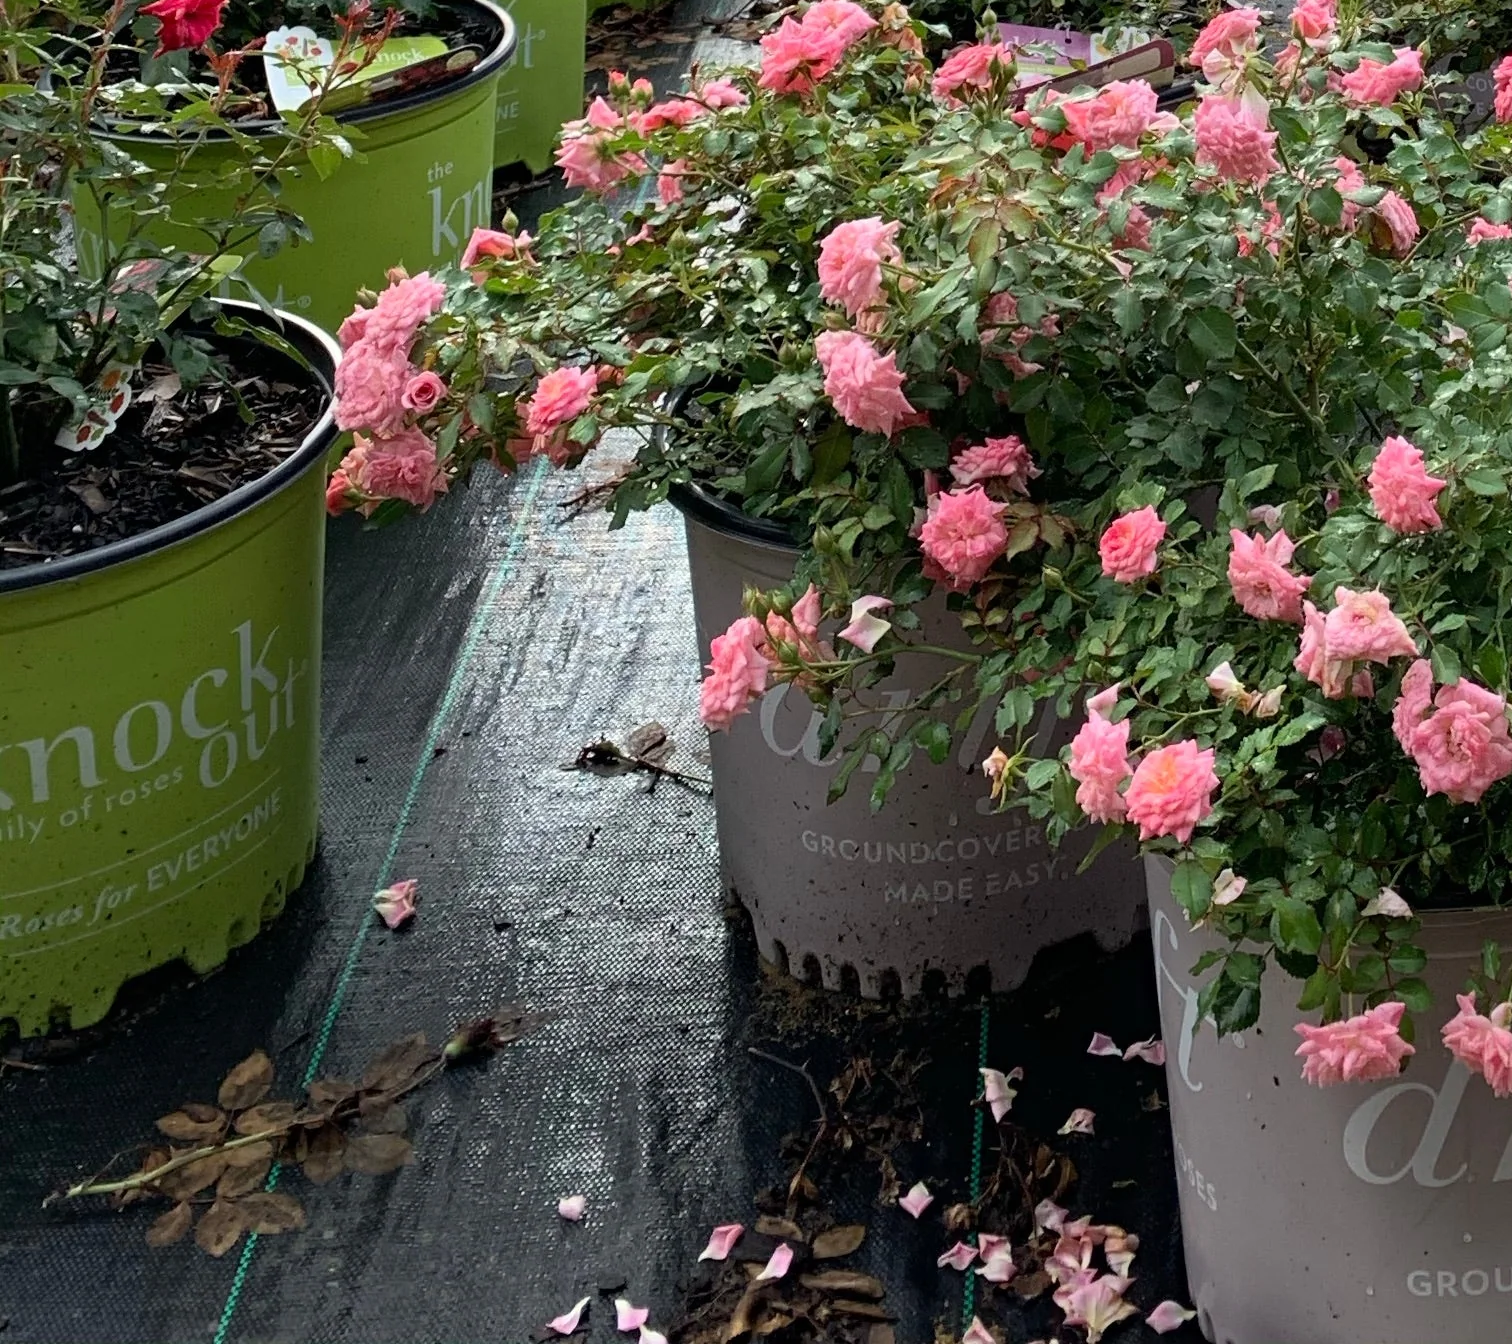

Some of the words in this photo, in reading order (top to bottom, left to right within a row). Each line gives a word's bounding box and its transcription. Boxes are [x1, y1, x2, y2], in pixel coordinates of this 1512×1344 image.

[427, 161, 454, 183] the
[0, 815, 45, 845] ily
[60, 794, 95, 828] of
[105, 766, 184, 813] roses
[0, 906, 84, 940] Roses
[86, 881, 139, 927] for
[147, 786, 283, 892] EVERYONE
[801, 825, 1042, 865] GROUNDCOVER
[884, 876, 973, 904] MADE
[986, 856, 1066, 897] EASY
[1178, 1141, 1218, 1212] OSES
